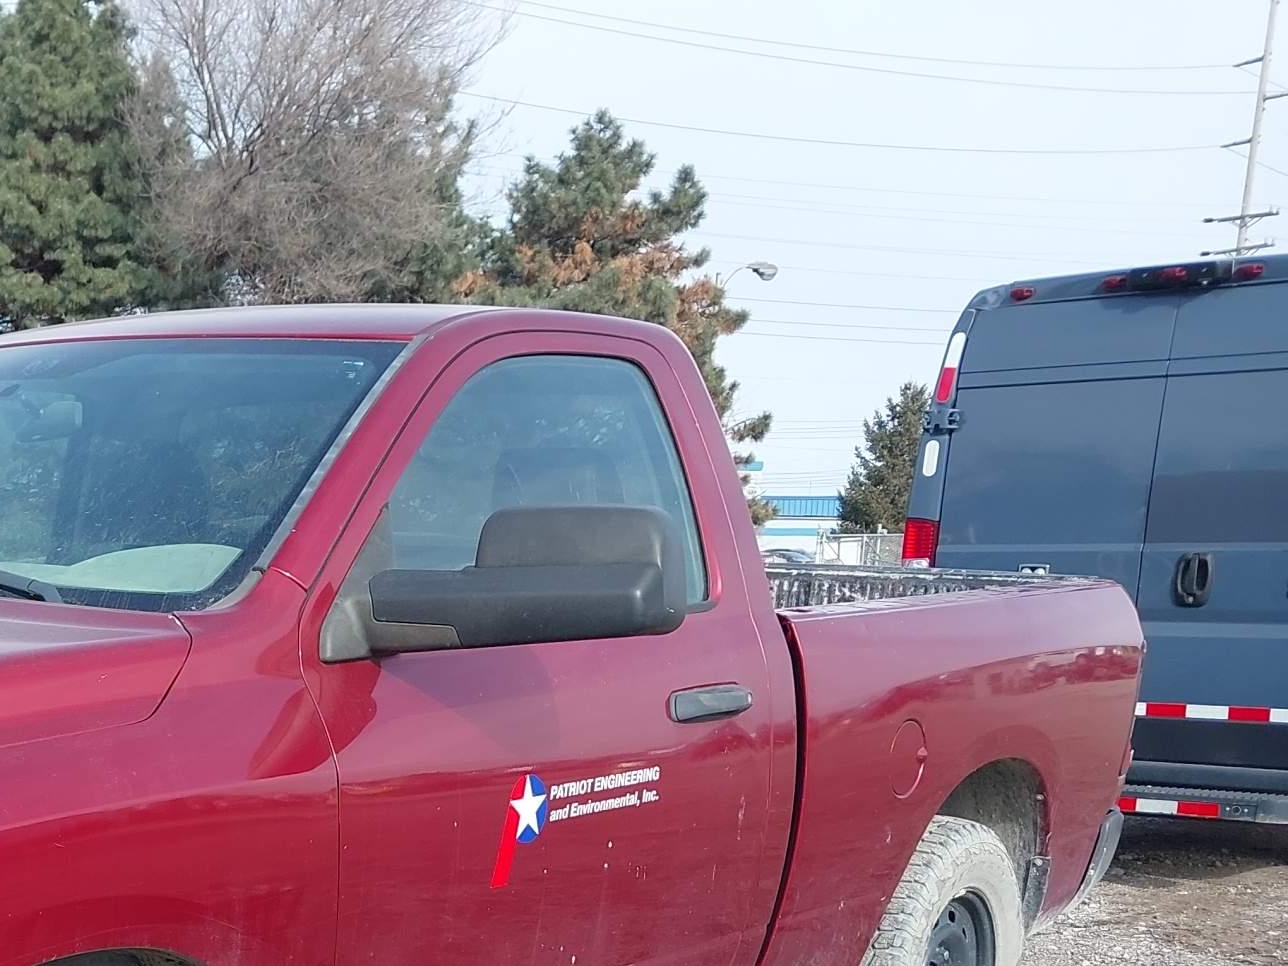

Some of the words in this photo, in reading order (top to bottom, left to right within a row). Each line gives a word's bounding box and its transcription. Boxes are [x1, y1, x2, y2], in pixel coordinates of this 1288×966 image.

[550, 779, 594, 800] PATRIOT
[594, 767, 660, 792] ENGINEERING
[549, 805, 570, 822] and
[569, 792, 640, 818] Environmental,
[641, 789, 659, 802] Inc.
